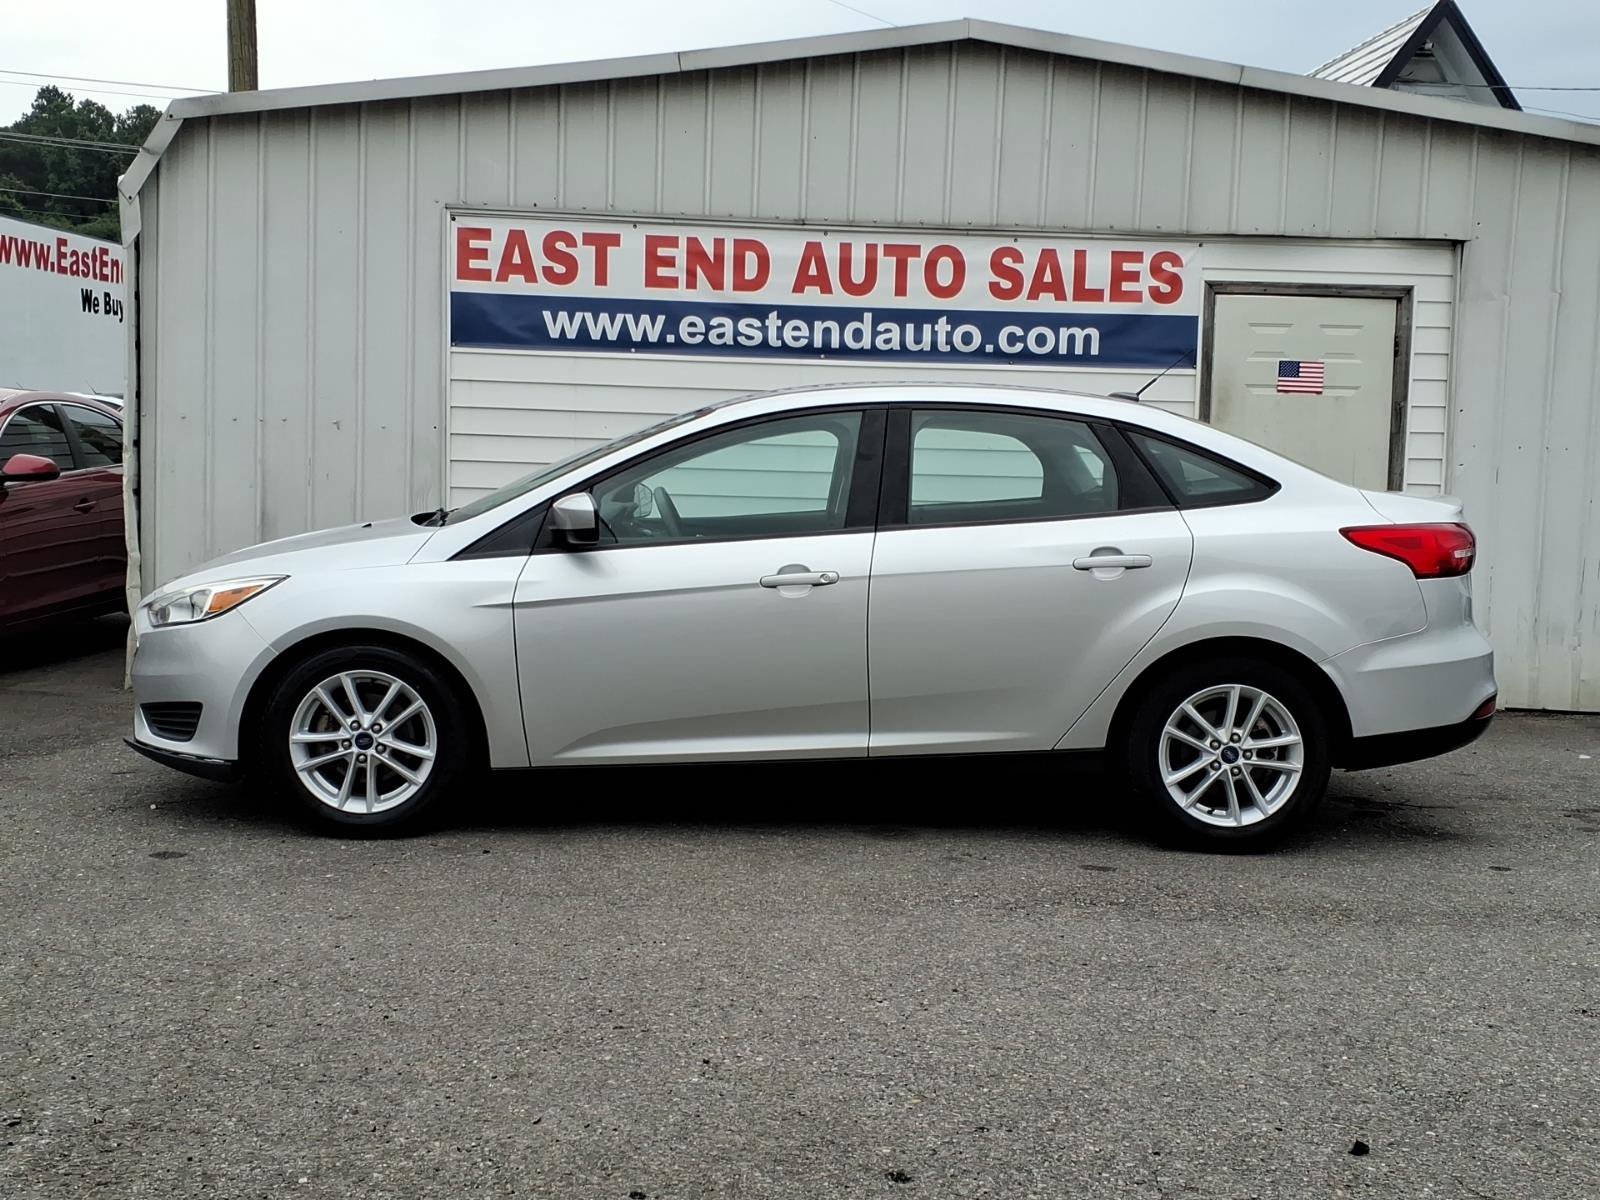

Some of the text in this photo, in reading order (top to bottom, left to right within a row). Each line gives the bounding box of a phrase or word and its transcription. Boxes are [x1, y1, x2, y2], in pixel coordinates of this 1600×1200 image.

[0, 234, 124, 285] www.EastEn
[456, 226, 1184, 305] EAST END AUTO SALES
[81, 287, 100, 314] We
[542, 310, 1100, 356] www.eastendauto.com
